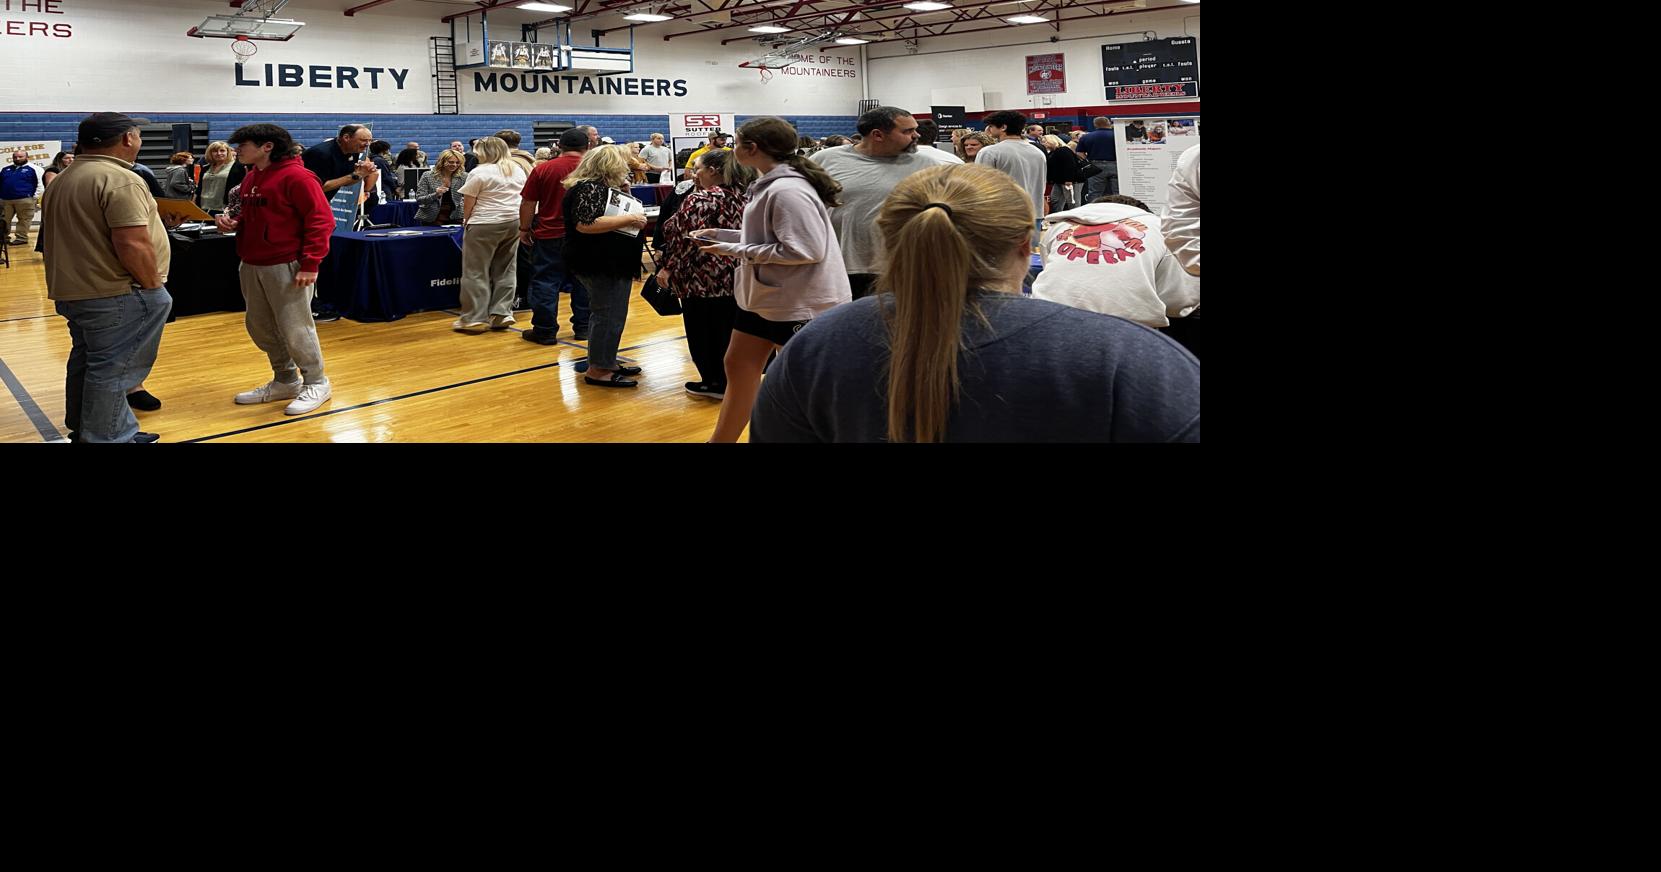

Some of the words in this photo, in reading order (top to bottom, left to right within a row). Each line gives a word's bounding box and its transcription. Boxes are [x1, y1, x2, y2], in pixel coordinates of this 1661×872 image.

[0, 20, 72, 38] ERS
[819, 55, 832, 64] OF
[837, 56, 855, 66] THE
[235, 62, 409, 90] LIBERTY
[781, 66, 856, 78] MOUNTAINEERS
[474, 71, 688, 97] MOUNTAINEERS
[1114, 84, 1186, 95] LIBERTY
[685, 115, 720, 126] SR
